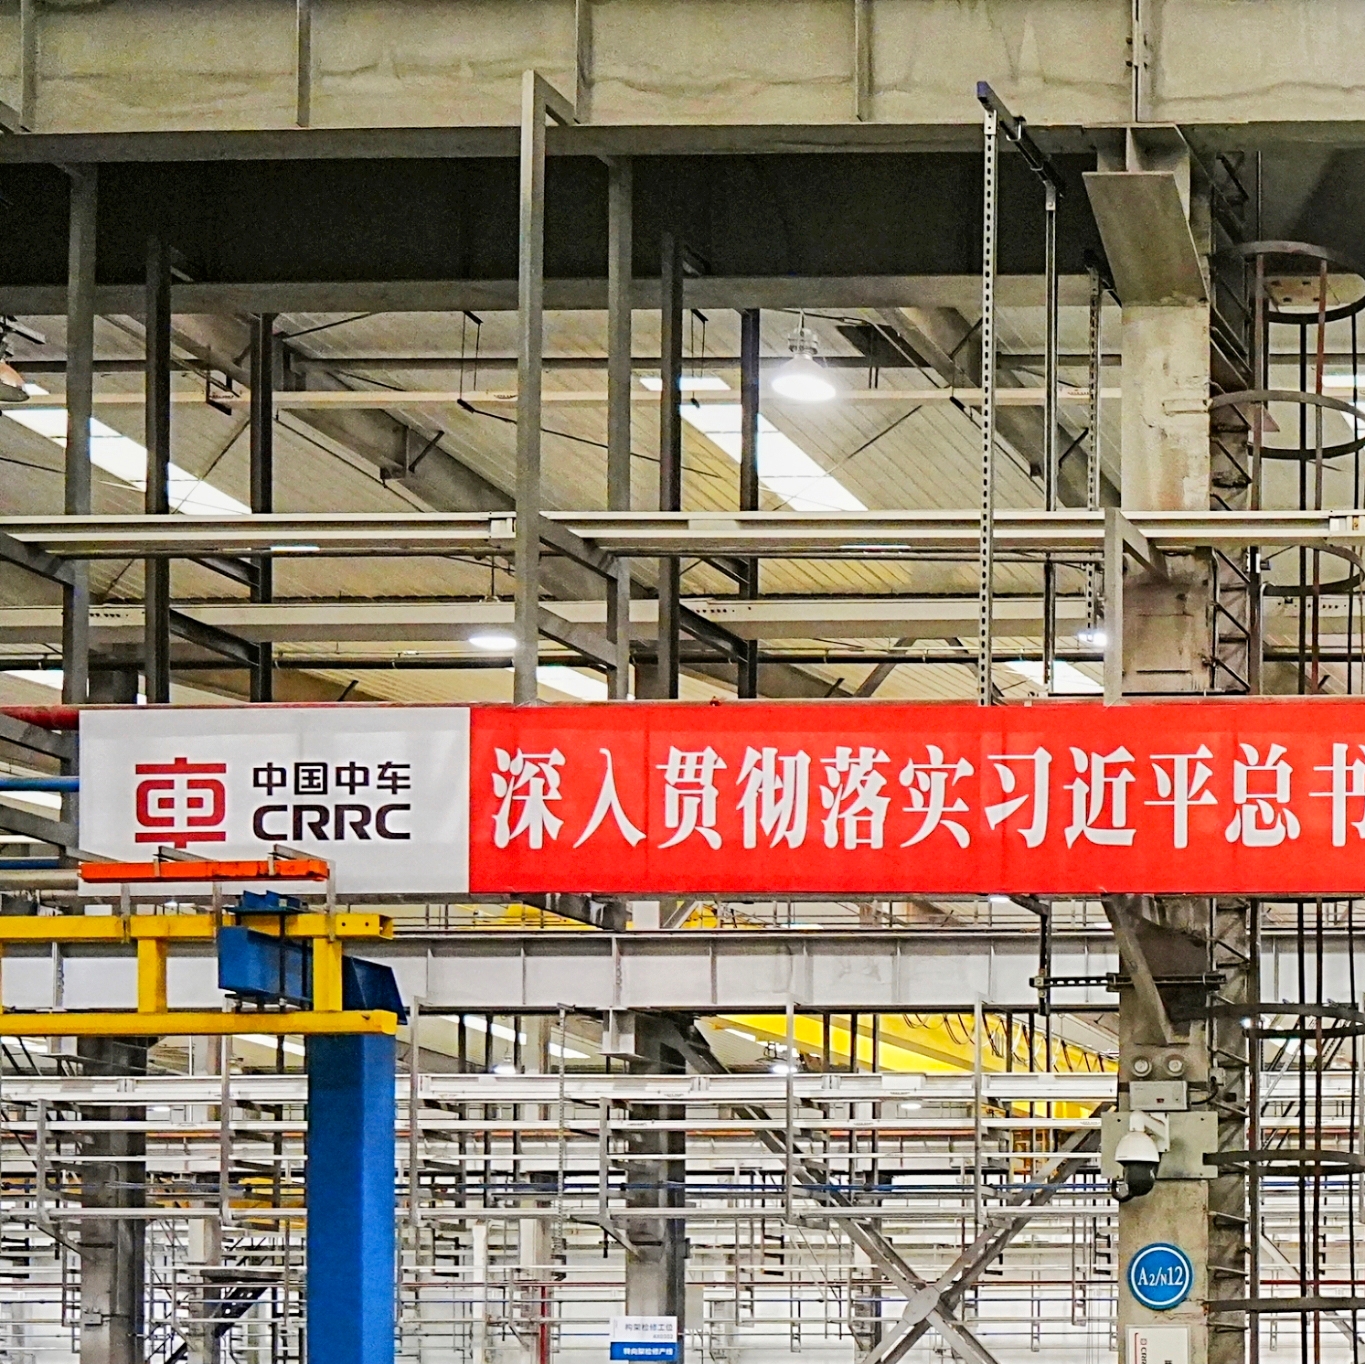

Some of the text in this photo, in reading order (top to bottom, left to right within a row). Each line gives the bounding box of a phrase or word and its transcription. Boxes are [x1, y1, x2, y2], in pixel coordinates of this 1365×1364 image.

[254, 762, 410, 795] 中国中车
[253, 804, 410, 841] CRRC
[1138, 1266, 1183, 1287] A2/N12
